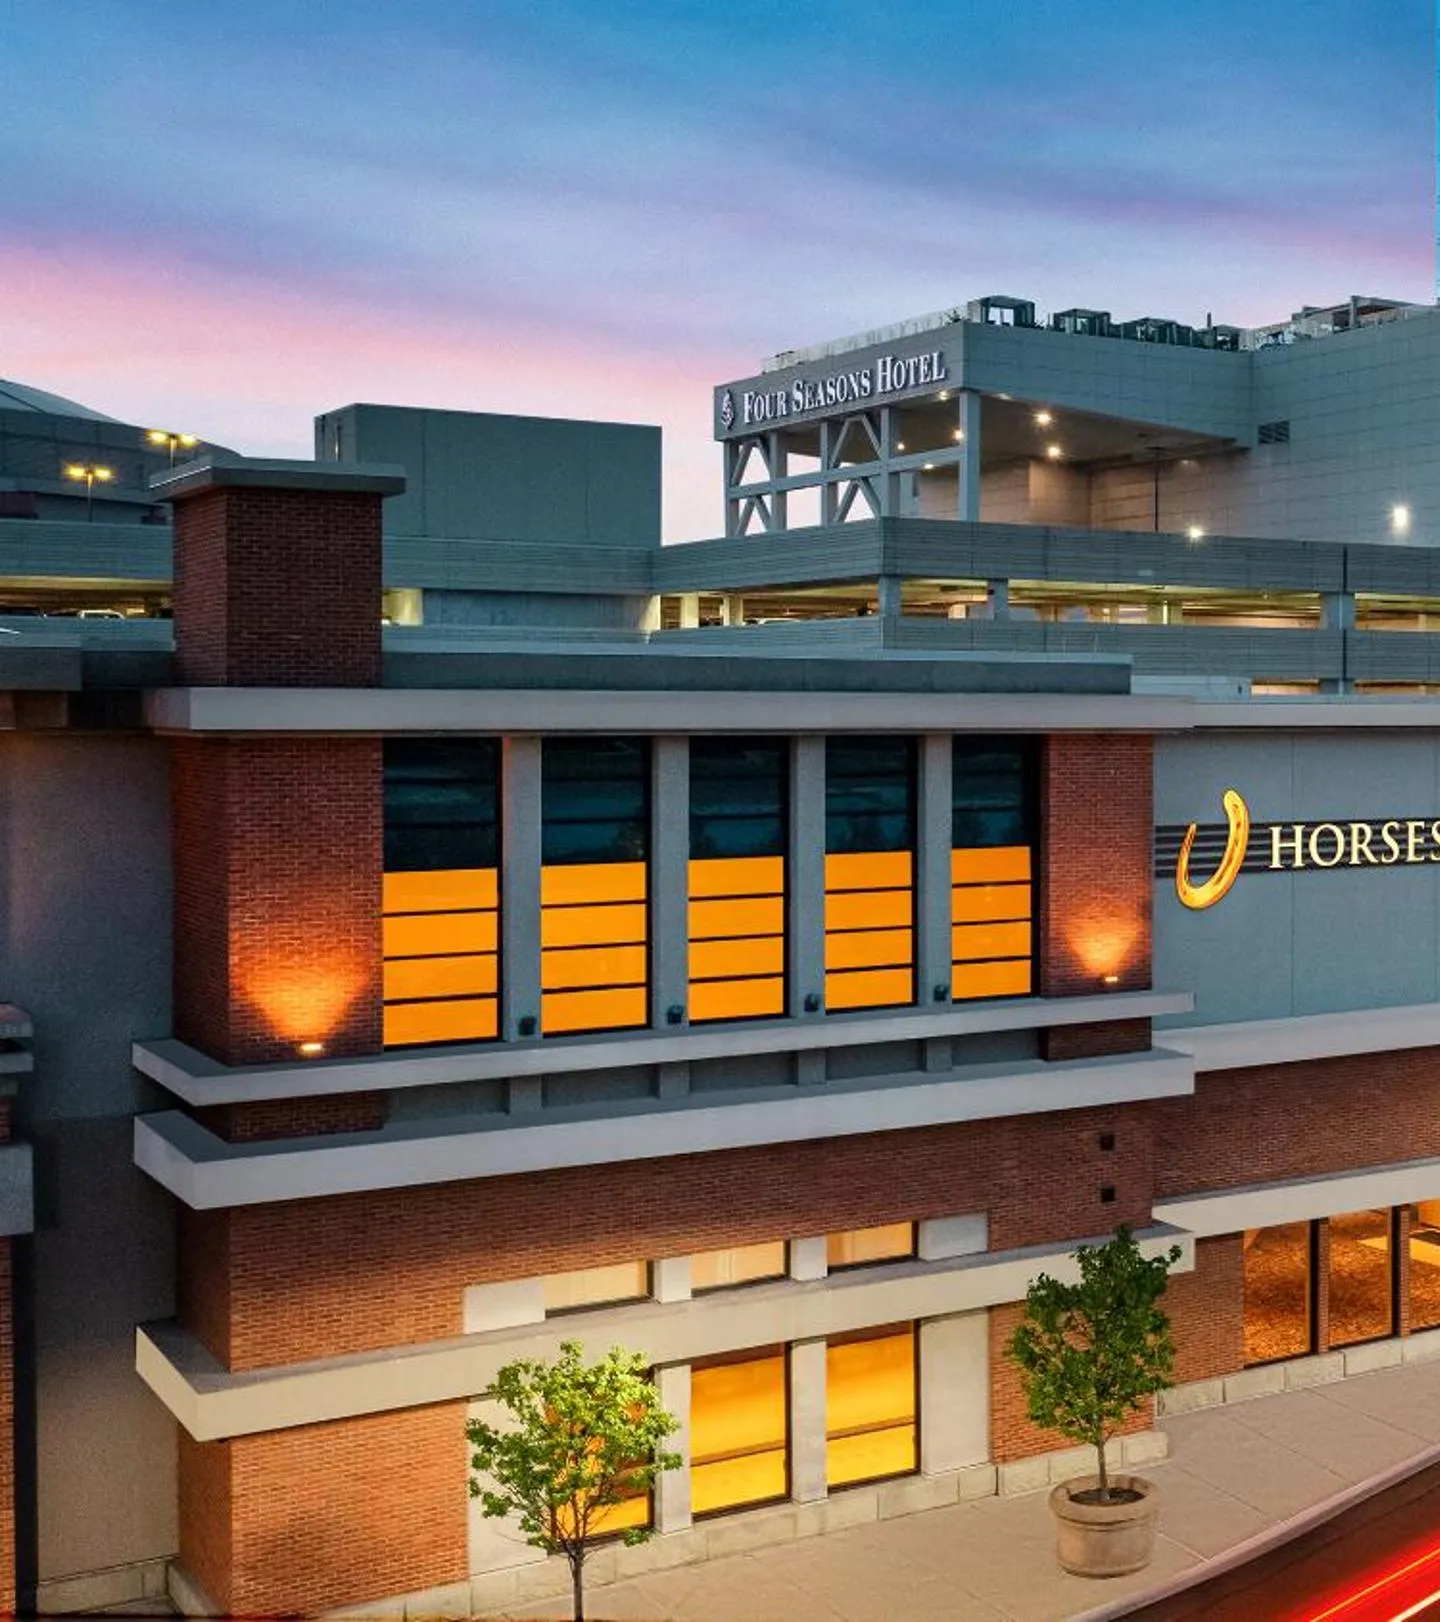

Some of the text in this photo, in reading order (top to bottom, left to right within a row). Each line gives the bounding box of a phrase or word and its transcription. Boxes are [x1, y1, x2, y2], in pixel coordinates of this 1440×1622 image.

[743, 352, 946, 424] FOUR SEASONS HOTEL
